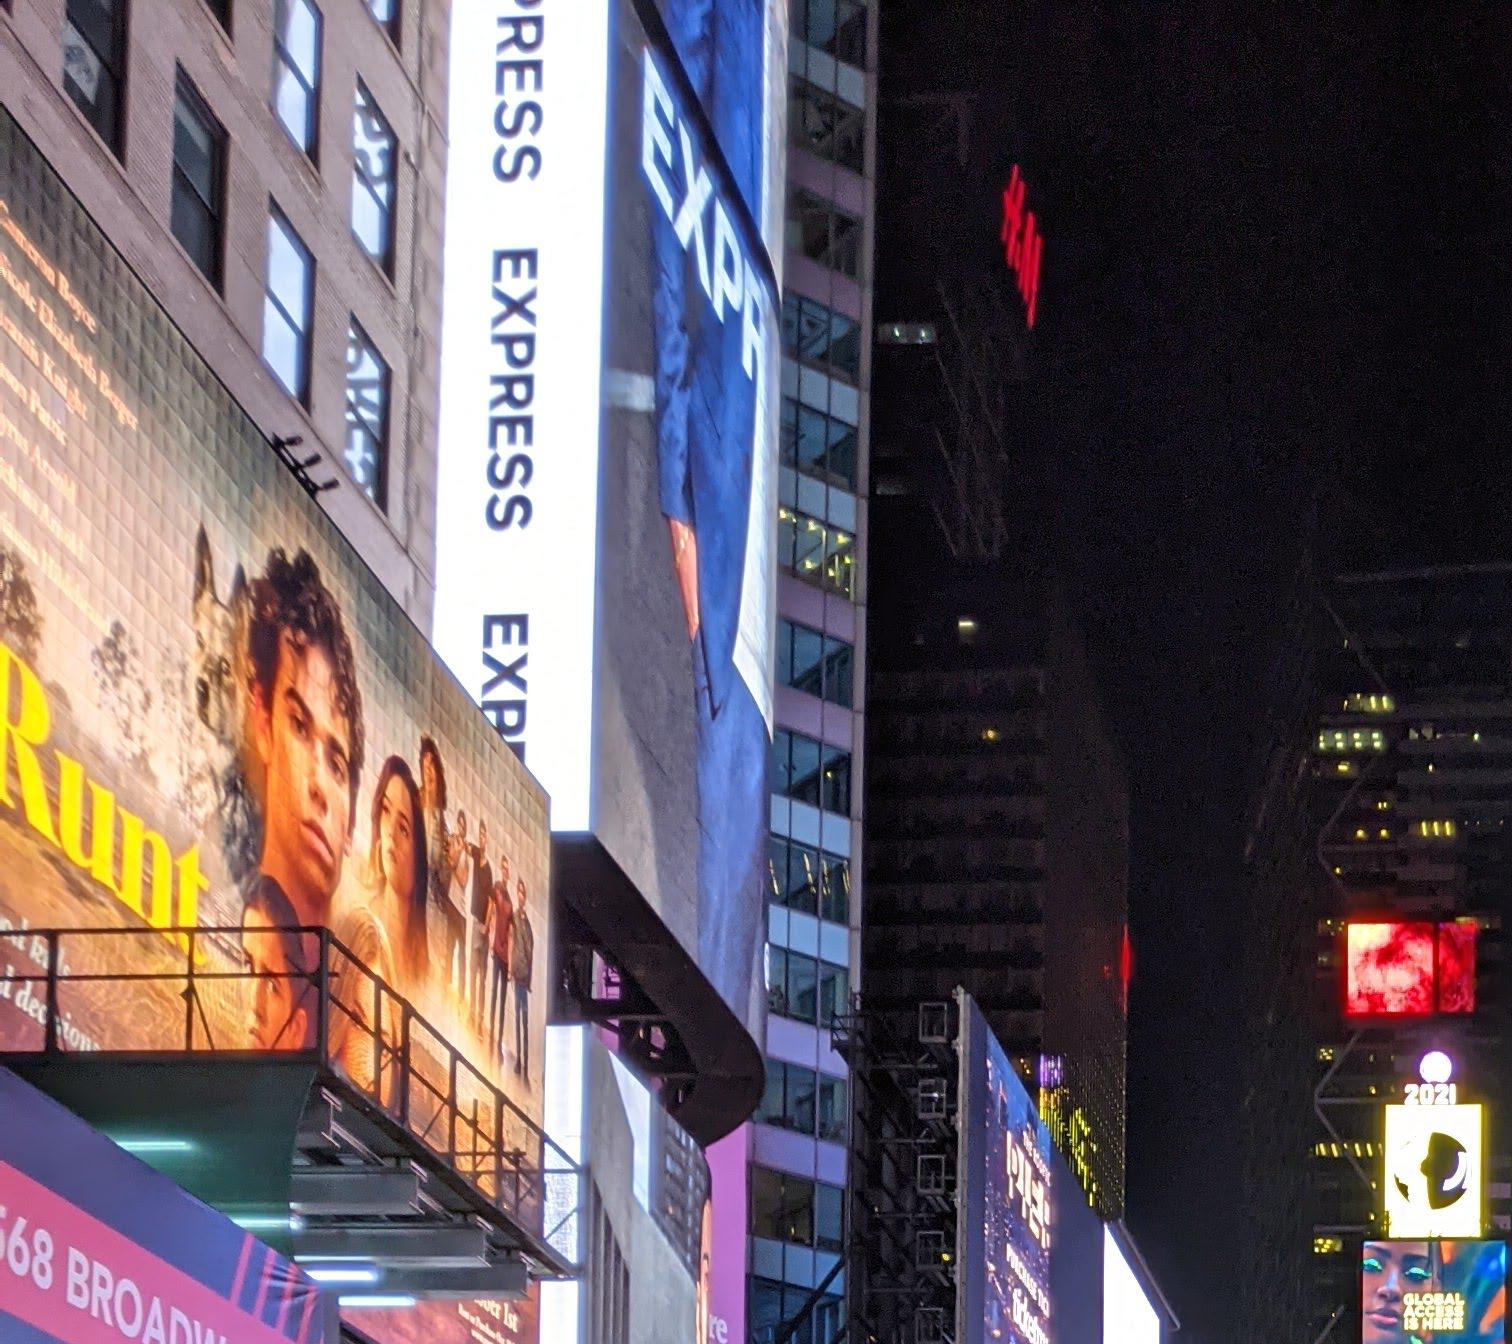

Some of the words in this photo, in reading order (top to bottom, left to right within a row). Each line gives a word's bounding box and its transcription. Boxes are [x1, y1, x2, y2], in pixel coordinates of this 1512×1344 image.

[492, 0, 544, 184] RESS
[485, 248, 539, 532] EXPRESS
[1404, 1083, 1457, 1106] 2021
[1403, 1293, 1465, 1306] GLOBAL
[1403, 1305, 1465, 1319] ACCESS
[1404, 1317, 1419, 1331] IS
[1422, 1317, 1464, 1331] HERE
